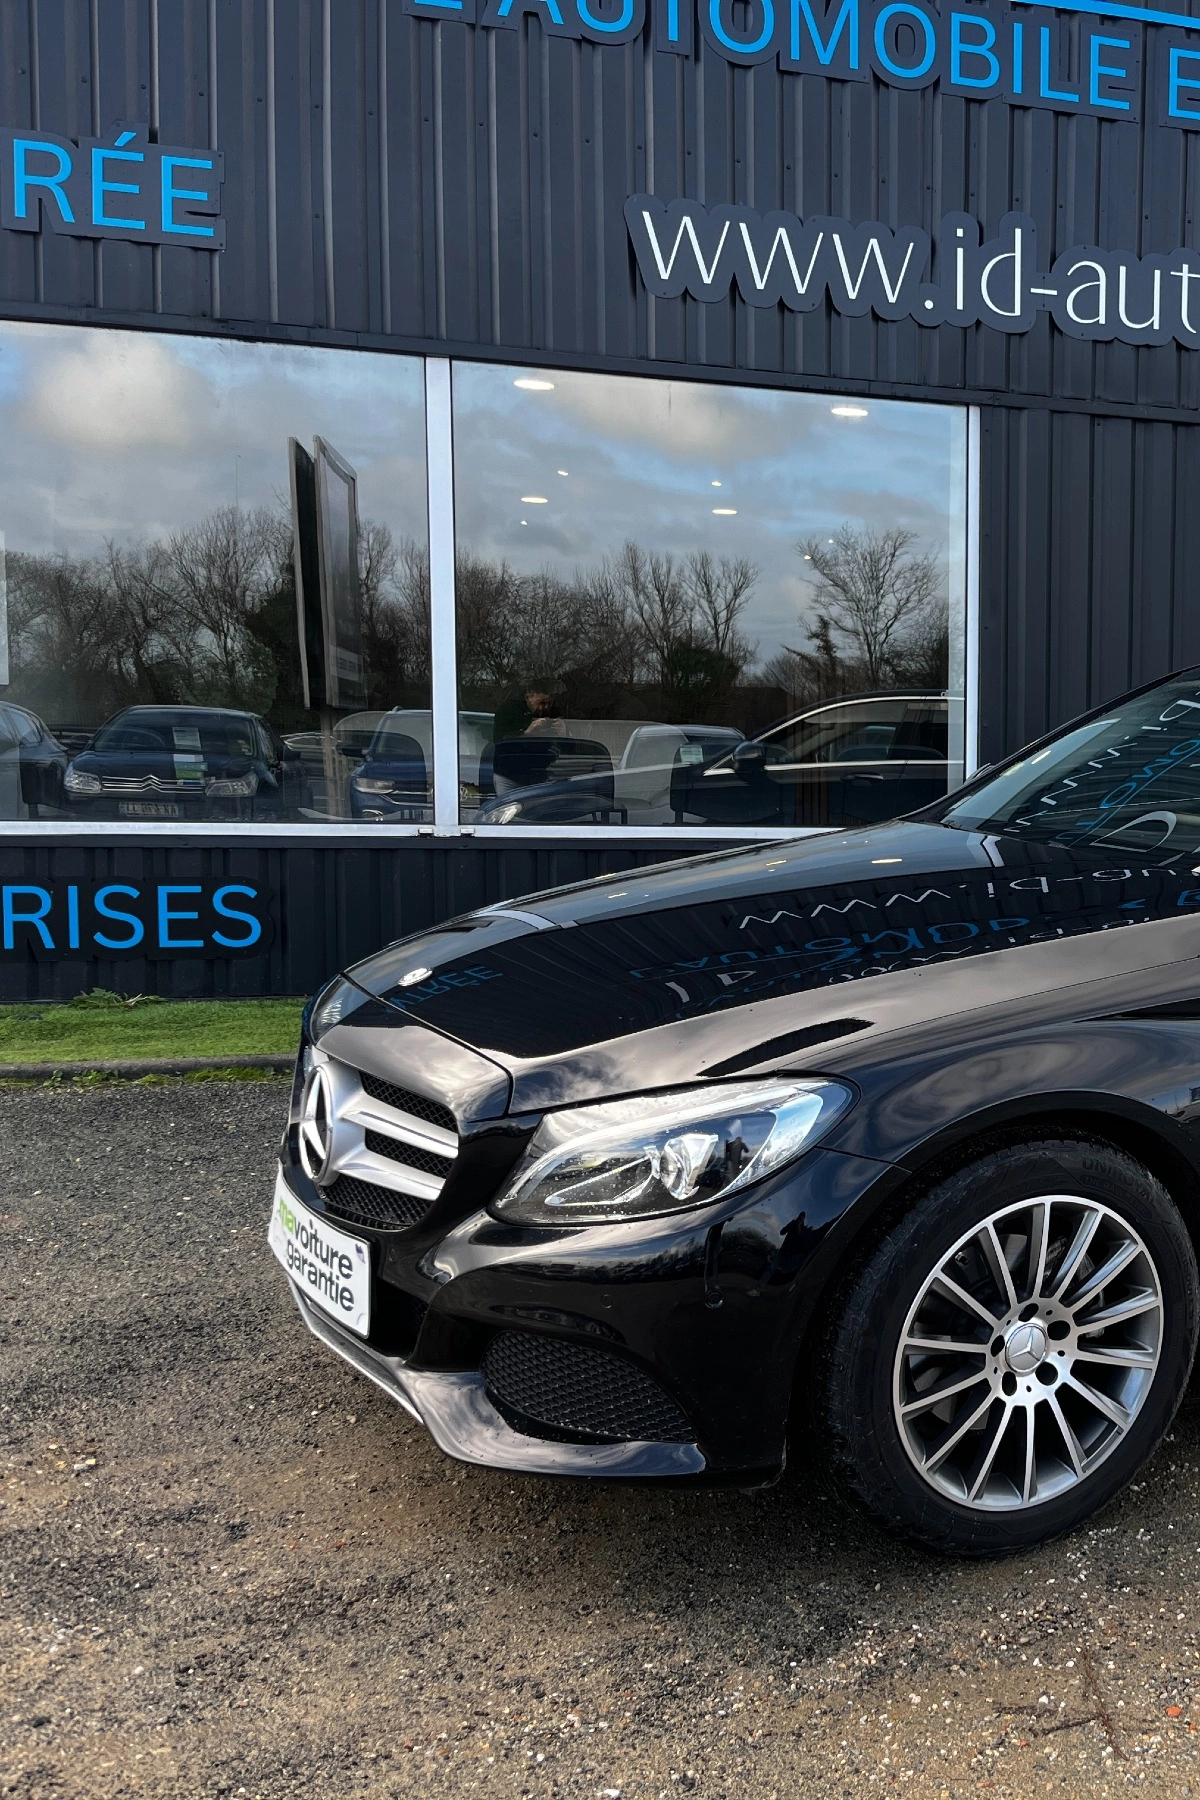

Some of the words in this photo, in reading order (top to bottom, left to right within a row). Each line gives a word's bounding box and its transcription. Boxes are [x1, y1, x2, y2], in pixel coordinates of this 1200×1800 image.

[415, 0, 1131, 111] OMOBILE
[13, 131, 215, 237] RÉE
[2, 884, 262, 949] RISES
[287, 1239, 355, 1311] garantie
